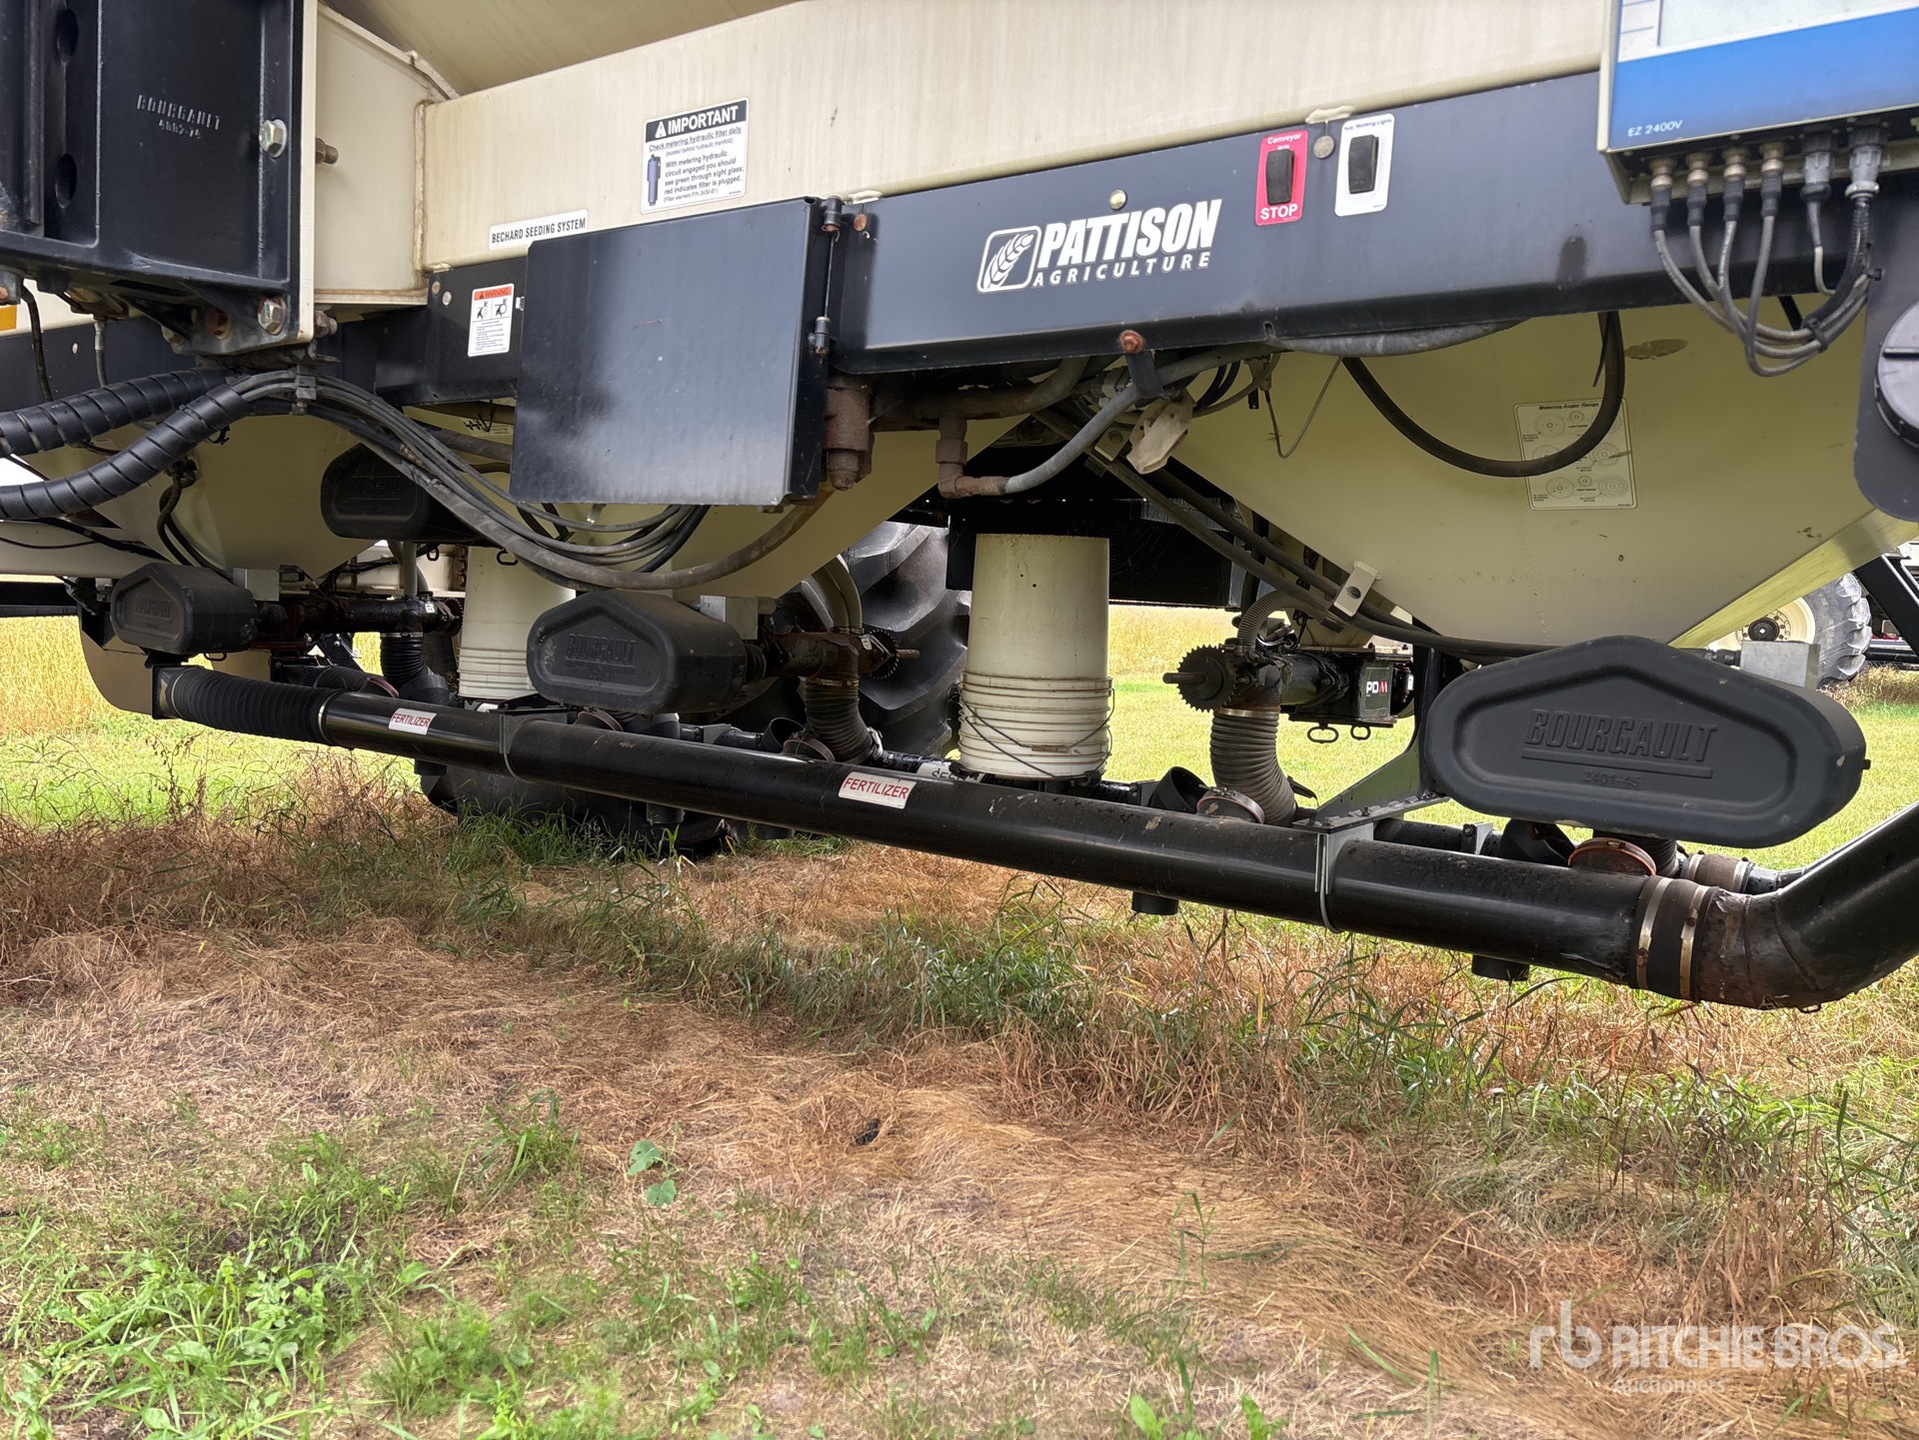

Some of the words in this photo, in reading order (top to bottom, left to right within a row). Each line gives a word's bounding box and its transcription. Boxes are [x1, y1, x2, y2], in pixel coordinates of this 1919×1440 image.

[668, 105, 739, 135] IMPORTANT
[1356, 121, 1376, 129] Working
[1627, 126, 1643, 137] EZ
[1645, 119, 1684, 134] 2400V
[649, 142, 665, 152] Check
[666, 138, 689, 149] metering
[690, 132, 714, 145] hydraulic
[715, 129, 728, 138] filter
[1267, 133, 1302, 145] Conveyor
[665, 168, 682, 178] circuit
[683, 164, 706, 175] engaged
[706, 162, 717, 170] you
[718, 157, 737, 167] should
[666, 160, 678, 168] With
[678, 156, 701, 167] metering
[702, 150, 728, 161] hydraulic
[675, 176, 690, 185] green
[691, 171, 713, 182] through
[713, 168, 727, 178] sight
[664, 186, 673, 195] red
[674, 183, 698, 193] indicates
[699, 179, 711, 188] filter
[1260, 203, 1298, 221] STOP
[492, 229, 524, 244] BECHARD
[525, 223, 556, 238] SEEDING
[557, 217, 587, 232] SYSTEM
[1037, 199, 1222, 269] PATTISON
[1033, 252, 1211, 288] AGRICULTURE
[485, 288, 509, 298] WARNING
[1366, 680, 1388, 694] PDM
[392, 712, 431, 728] FERTILIZER
[1524, 708, 1719, 763] BOURGAULT
[843, 777, 909, 799] FERTILIZER
